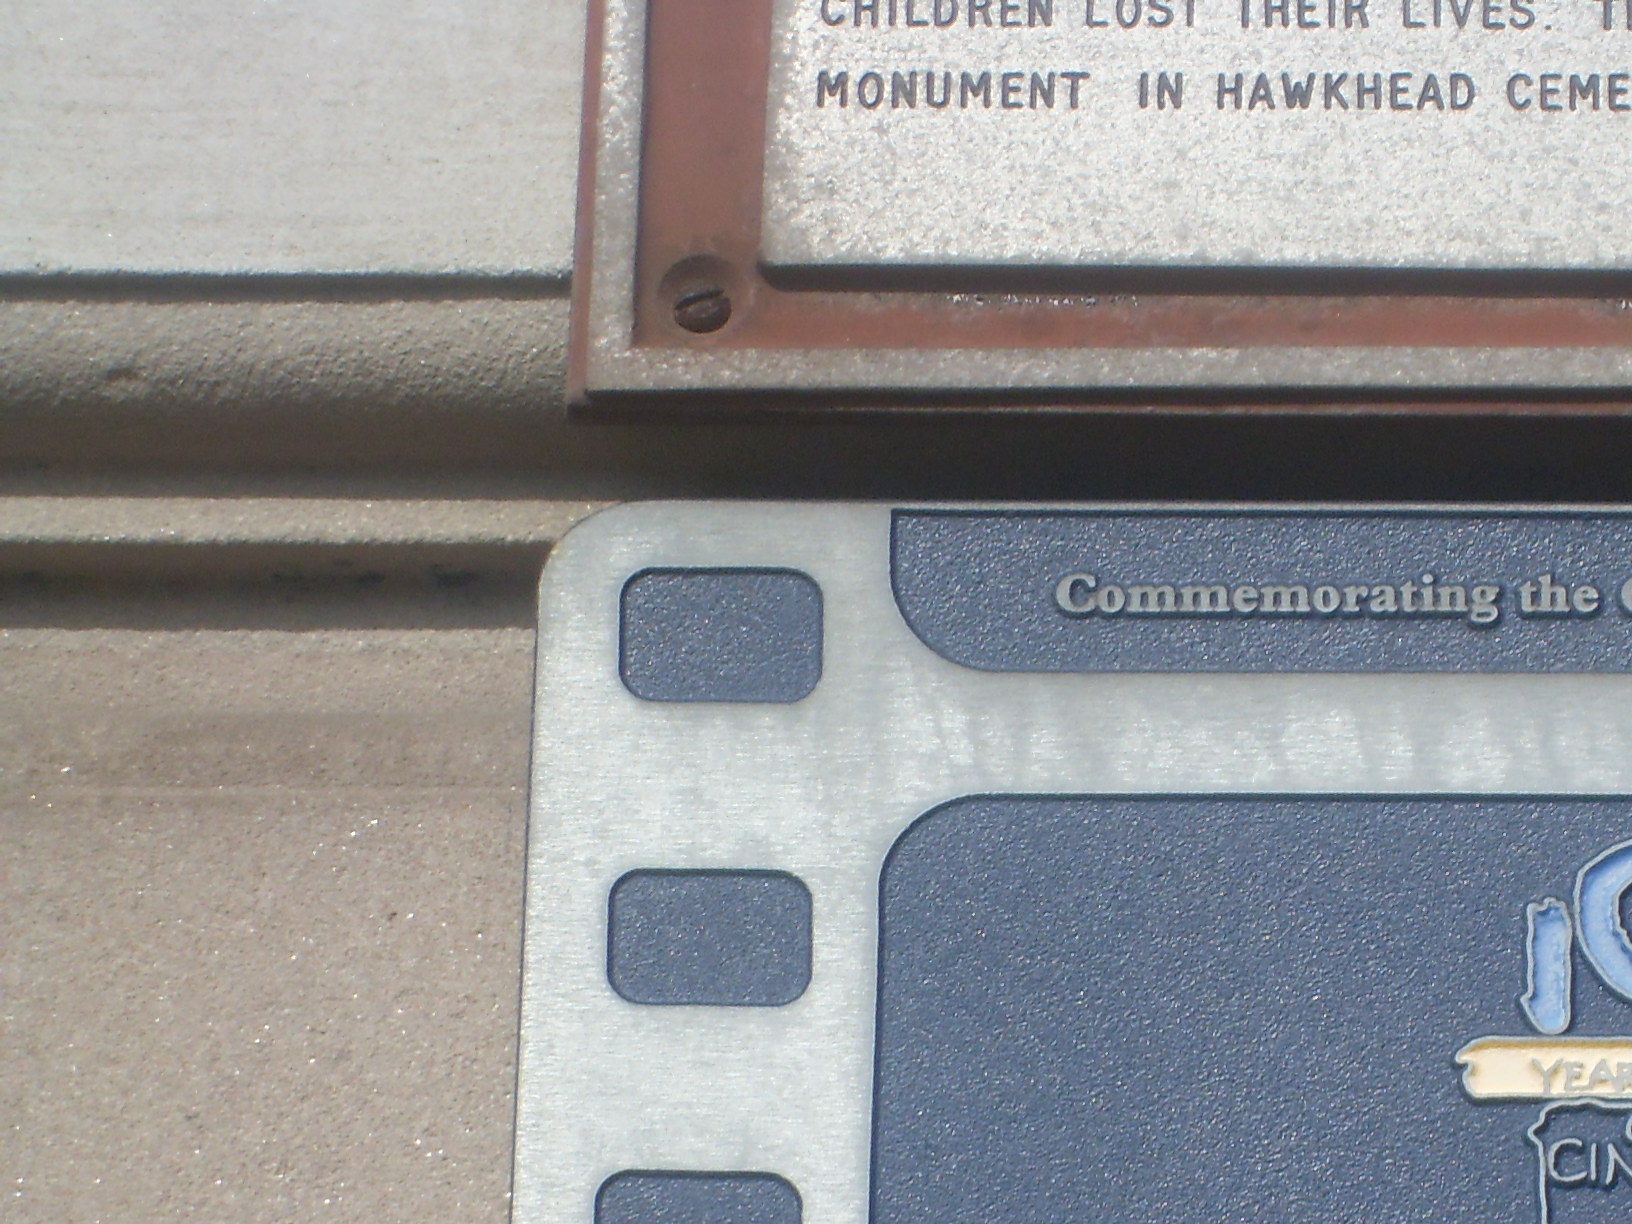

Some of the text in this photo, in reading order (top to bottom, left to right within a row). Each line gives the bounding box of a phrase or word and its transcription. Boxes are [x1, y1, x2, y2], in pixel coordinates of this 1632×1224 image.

[820, 0, 1054, 28] CHILDREN
[1086, 0, 1198, 29] LOST
[1237, 0, 1371, 29] THEIR
[1401, 0, 1555, 31] LIVES.
[815, 71, 1091, 110] MONUMENT
[1137, 72, 1183, 111] IN
[1217, 72, 1476, 112] HAWKHEAD
[1055, 573, 1500, 624] Commemorating
[1519, 574, 1599, 613] the
